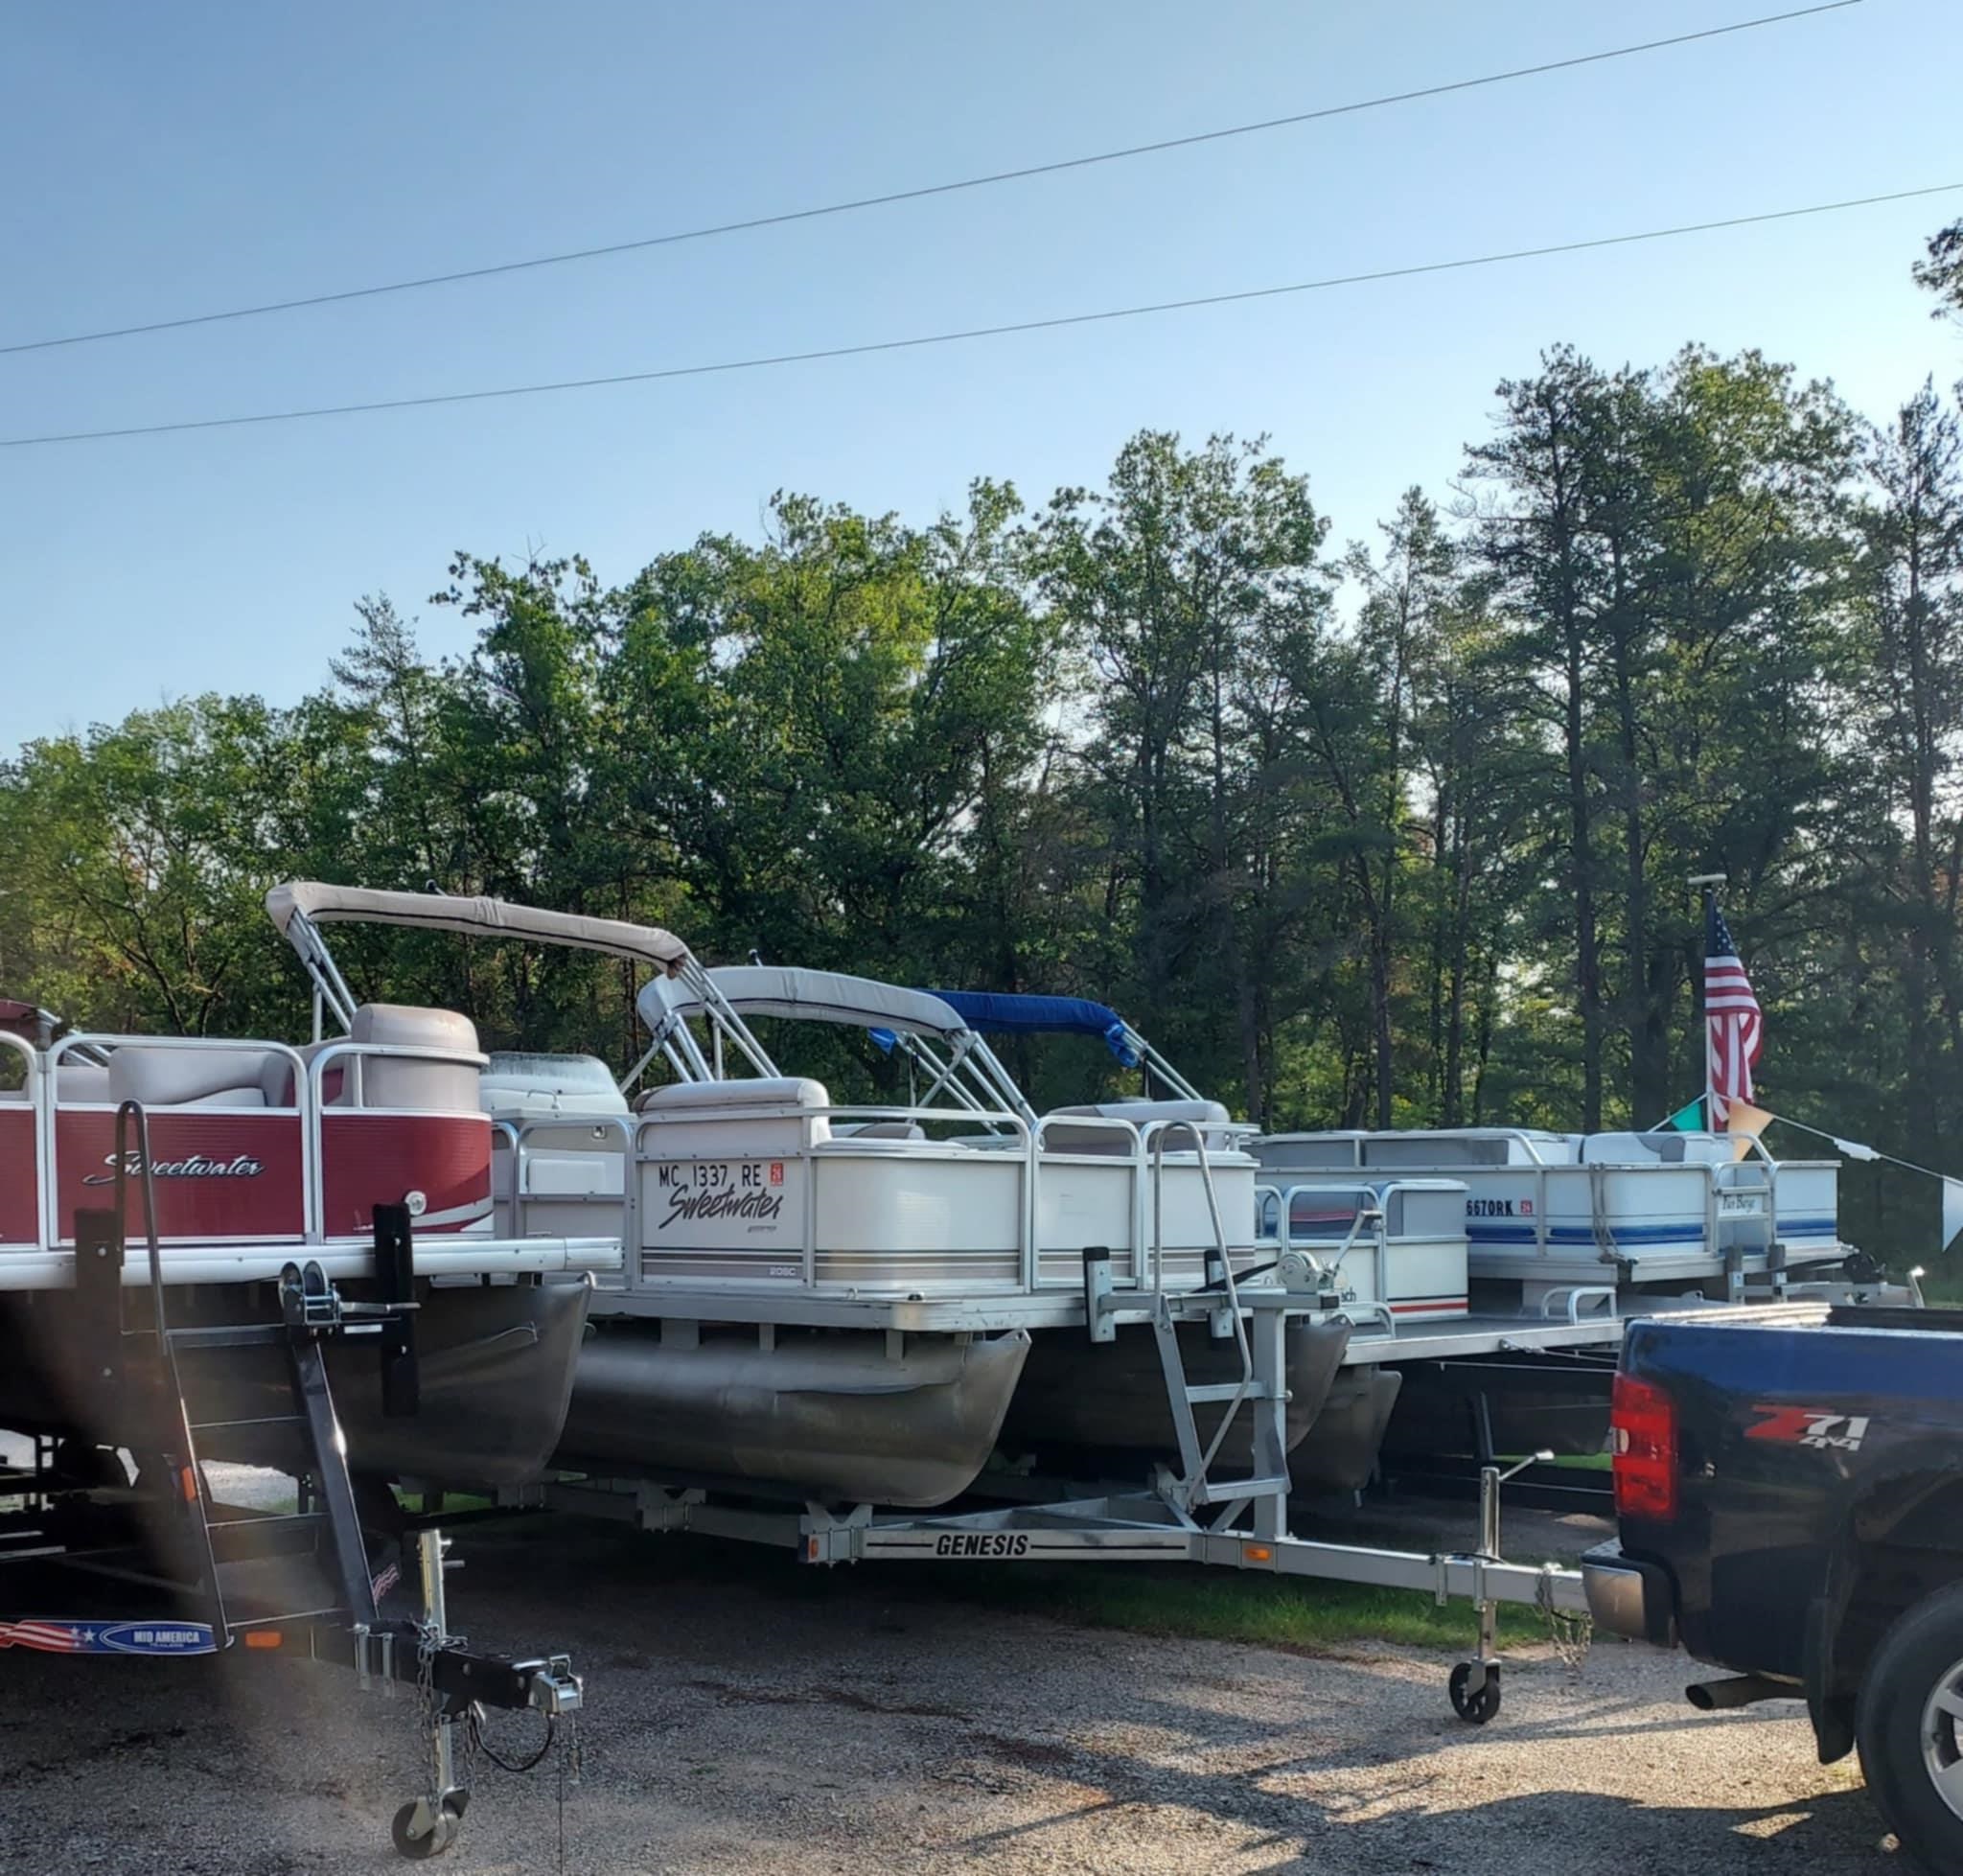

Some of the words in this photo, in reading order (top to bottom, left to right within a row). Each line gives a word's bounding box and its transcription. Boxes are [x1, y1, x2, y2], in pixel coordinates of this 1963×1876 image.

[658, 1164, 680, 1188] MC
[693, 1164, 728, 1188] 1337
[742, 1164, 761, 1187] RE
[658, 1183, 784, 1230] Sweetwater
[1744, 1404, 1870, 1442] Z71
[936, 1534, 1028, 1556] GENESIS
[133, 1631, 153, 1643] MID
[154, 1631, 200, 1643] AMERICA
